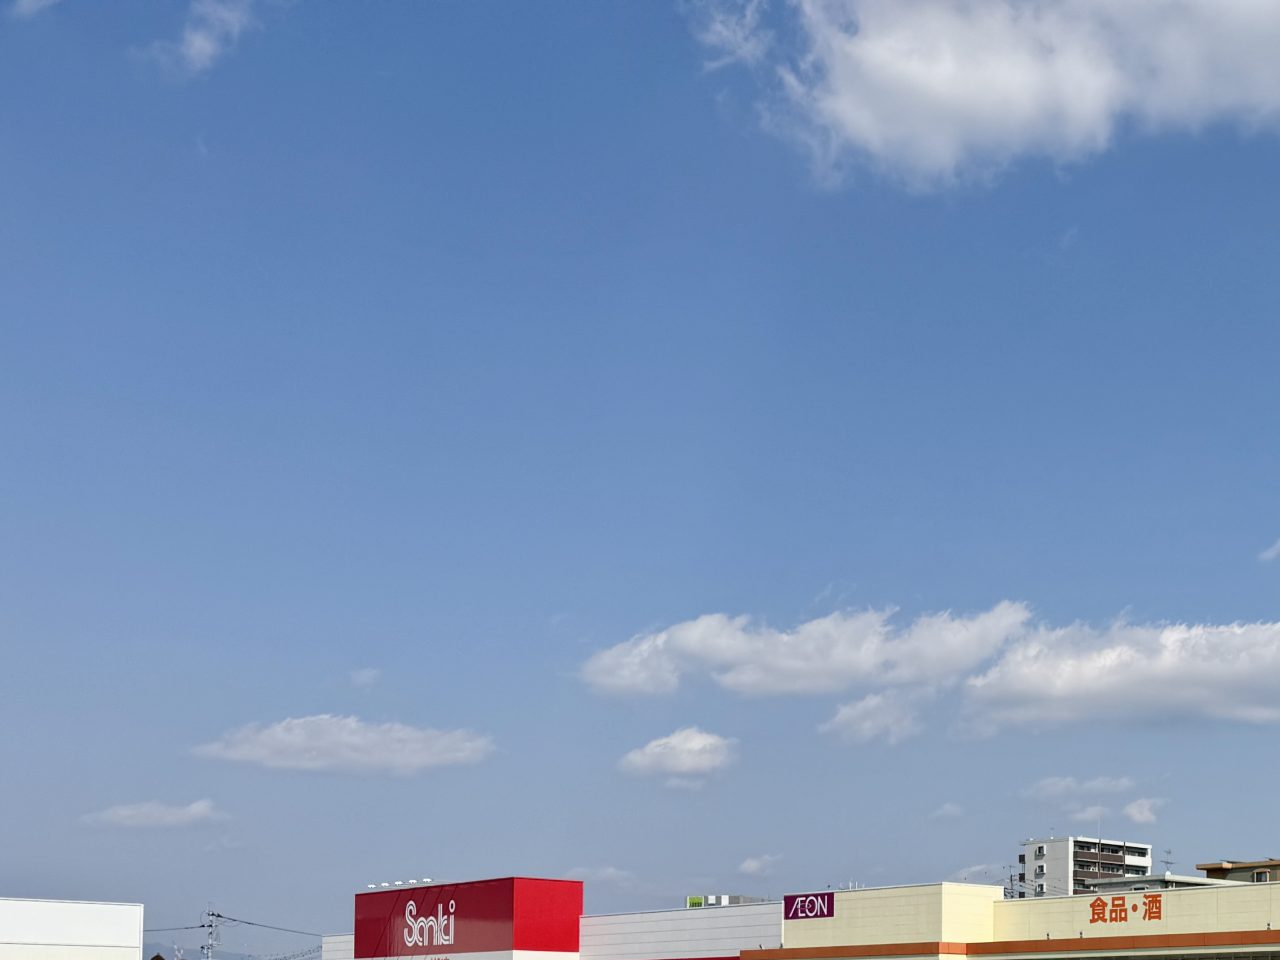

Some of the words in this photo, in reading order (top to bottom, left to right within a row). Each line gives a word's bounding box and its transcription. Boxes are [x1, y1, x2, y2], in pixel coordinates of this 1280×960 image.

[403, 899, 456, 947] Sanki
[1089, 893, 1163, 924] 食品・酒
